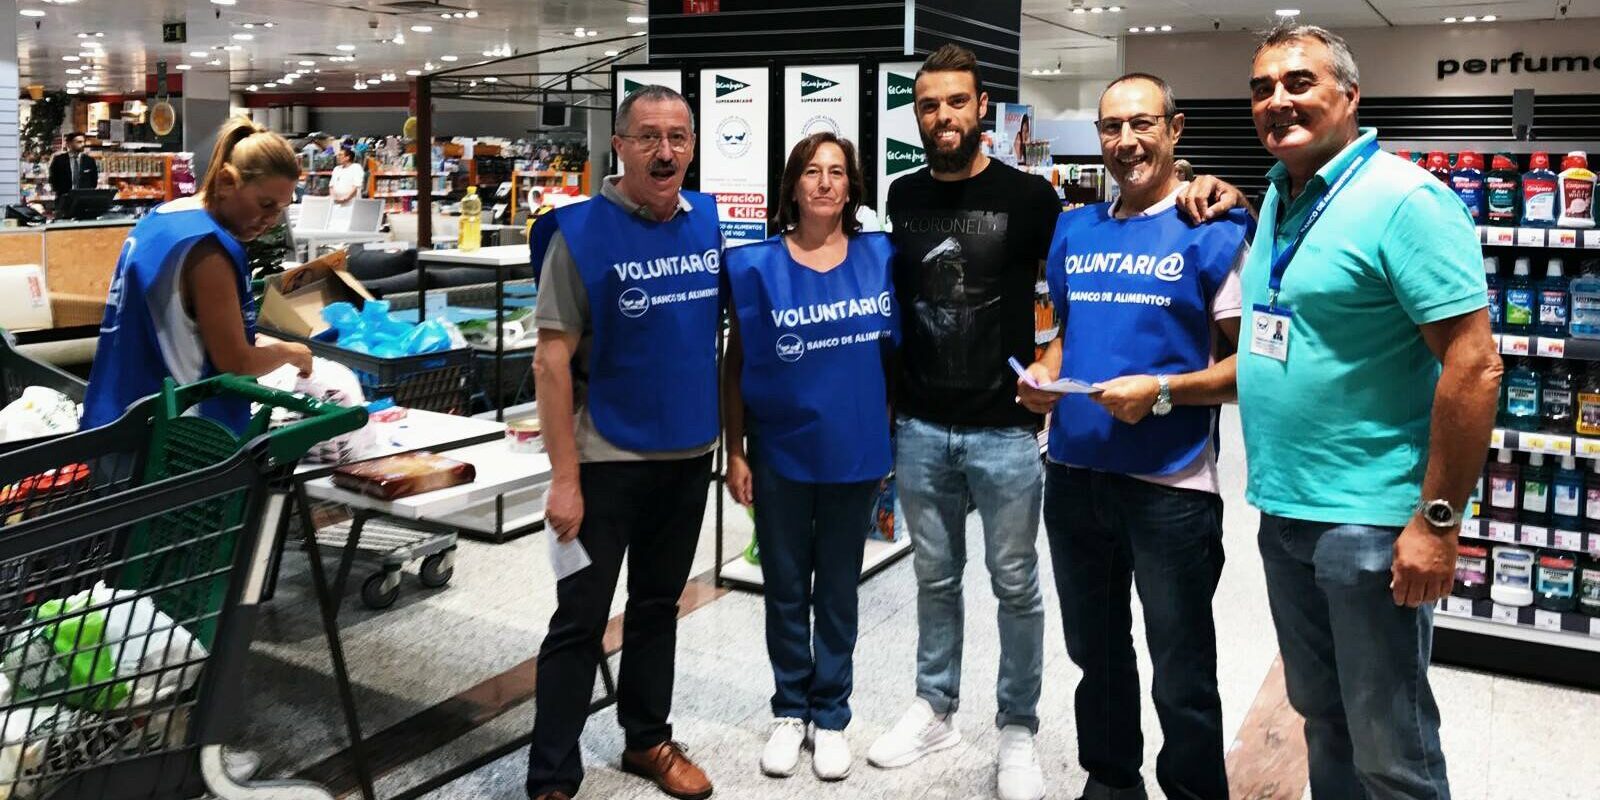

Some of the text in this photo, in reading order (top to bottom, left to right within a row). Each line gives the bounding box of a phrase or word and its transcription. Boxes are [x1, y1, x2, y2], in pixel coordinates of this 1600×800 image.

[716, 192, 763, 204] peración
[1316, 200, 1327, 212] DE
[734, 207, 767, 219] Kilo
[909, 216, 988, 235] CORONEL
[1065, 252, 1185, 282] OLUNTARI@
[1070, 291, 1172, 307] BANCO DE ALIMENTOS
[771, 291, 892, 328] VOLUNTARI@
[806, 337, 839, 351] BANCO
[841, 335, 853, 346] DE
